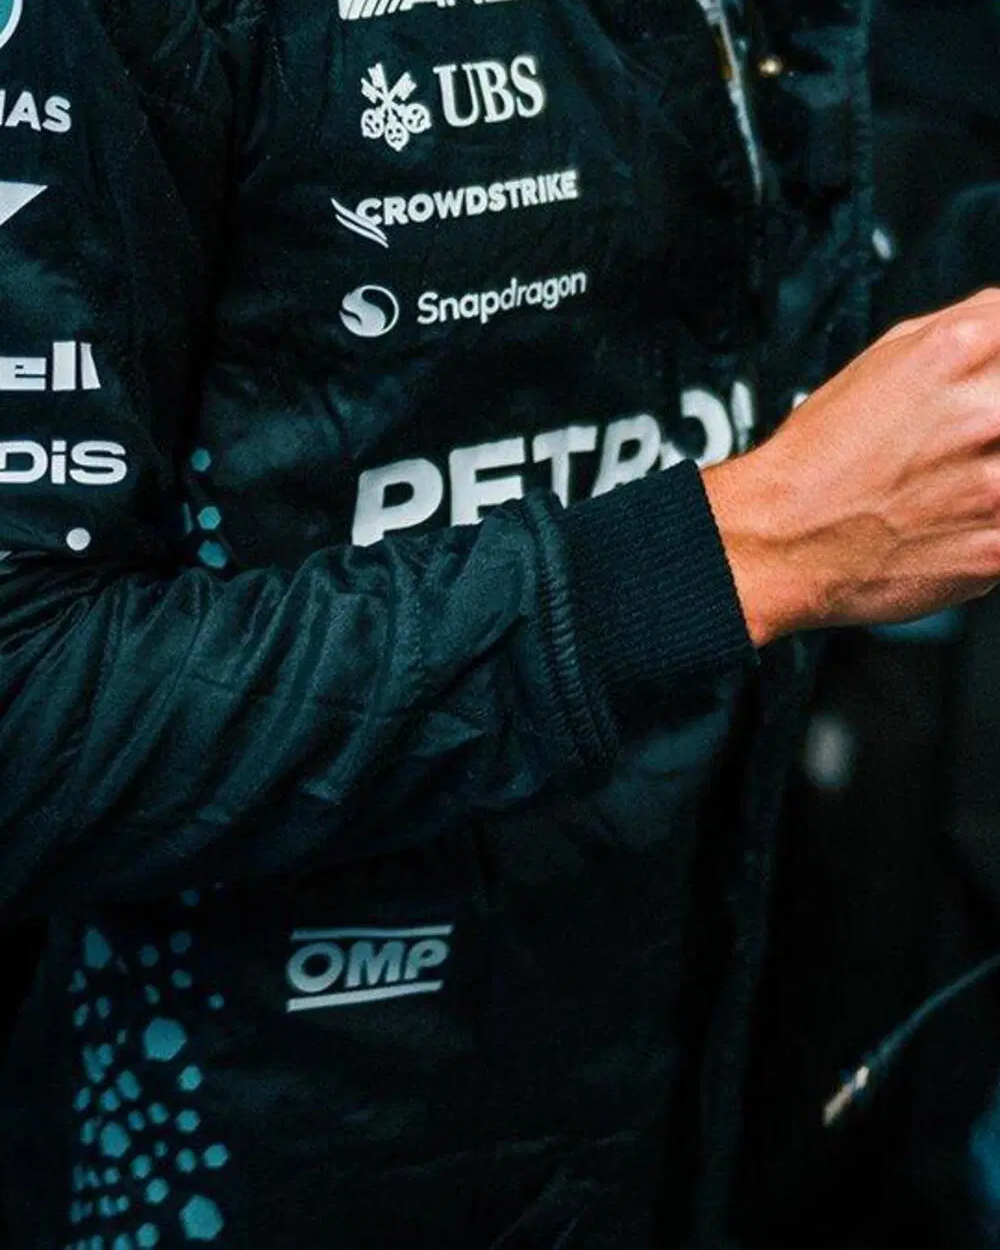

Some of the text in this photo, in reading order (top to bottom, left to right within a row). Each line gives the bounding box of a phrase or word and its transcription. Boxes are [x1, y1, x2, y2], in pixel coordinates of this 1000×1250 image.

[432, 54, 544, 128] UBS
[355, 169, 579, 227] CROWDSTRIKE
[416, 270, 587, 325] Snapdragon
[287, 939, 449, 994] OMP
